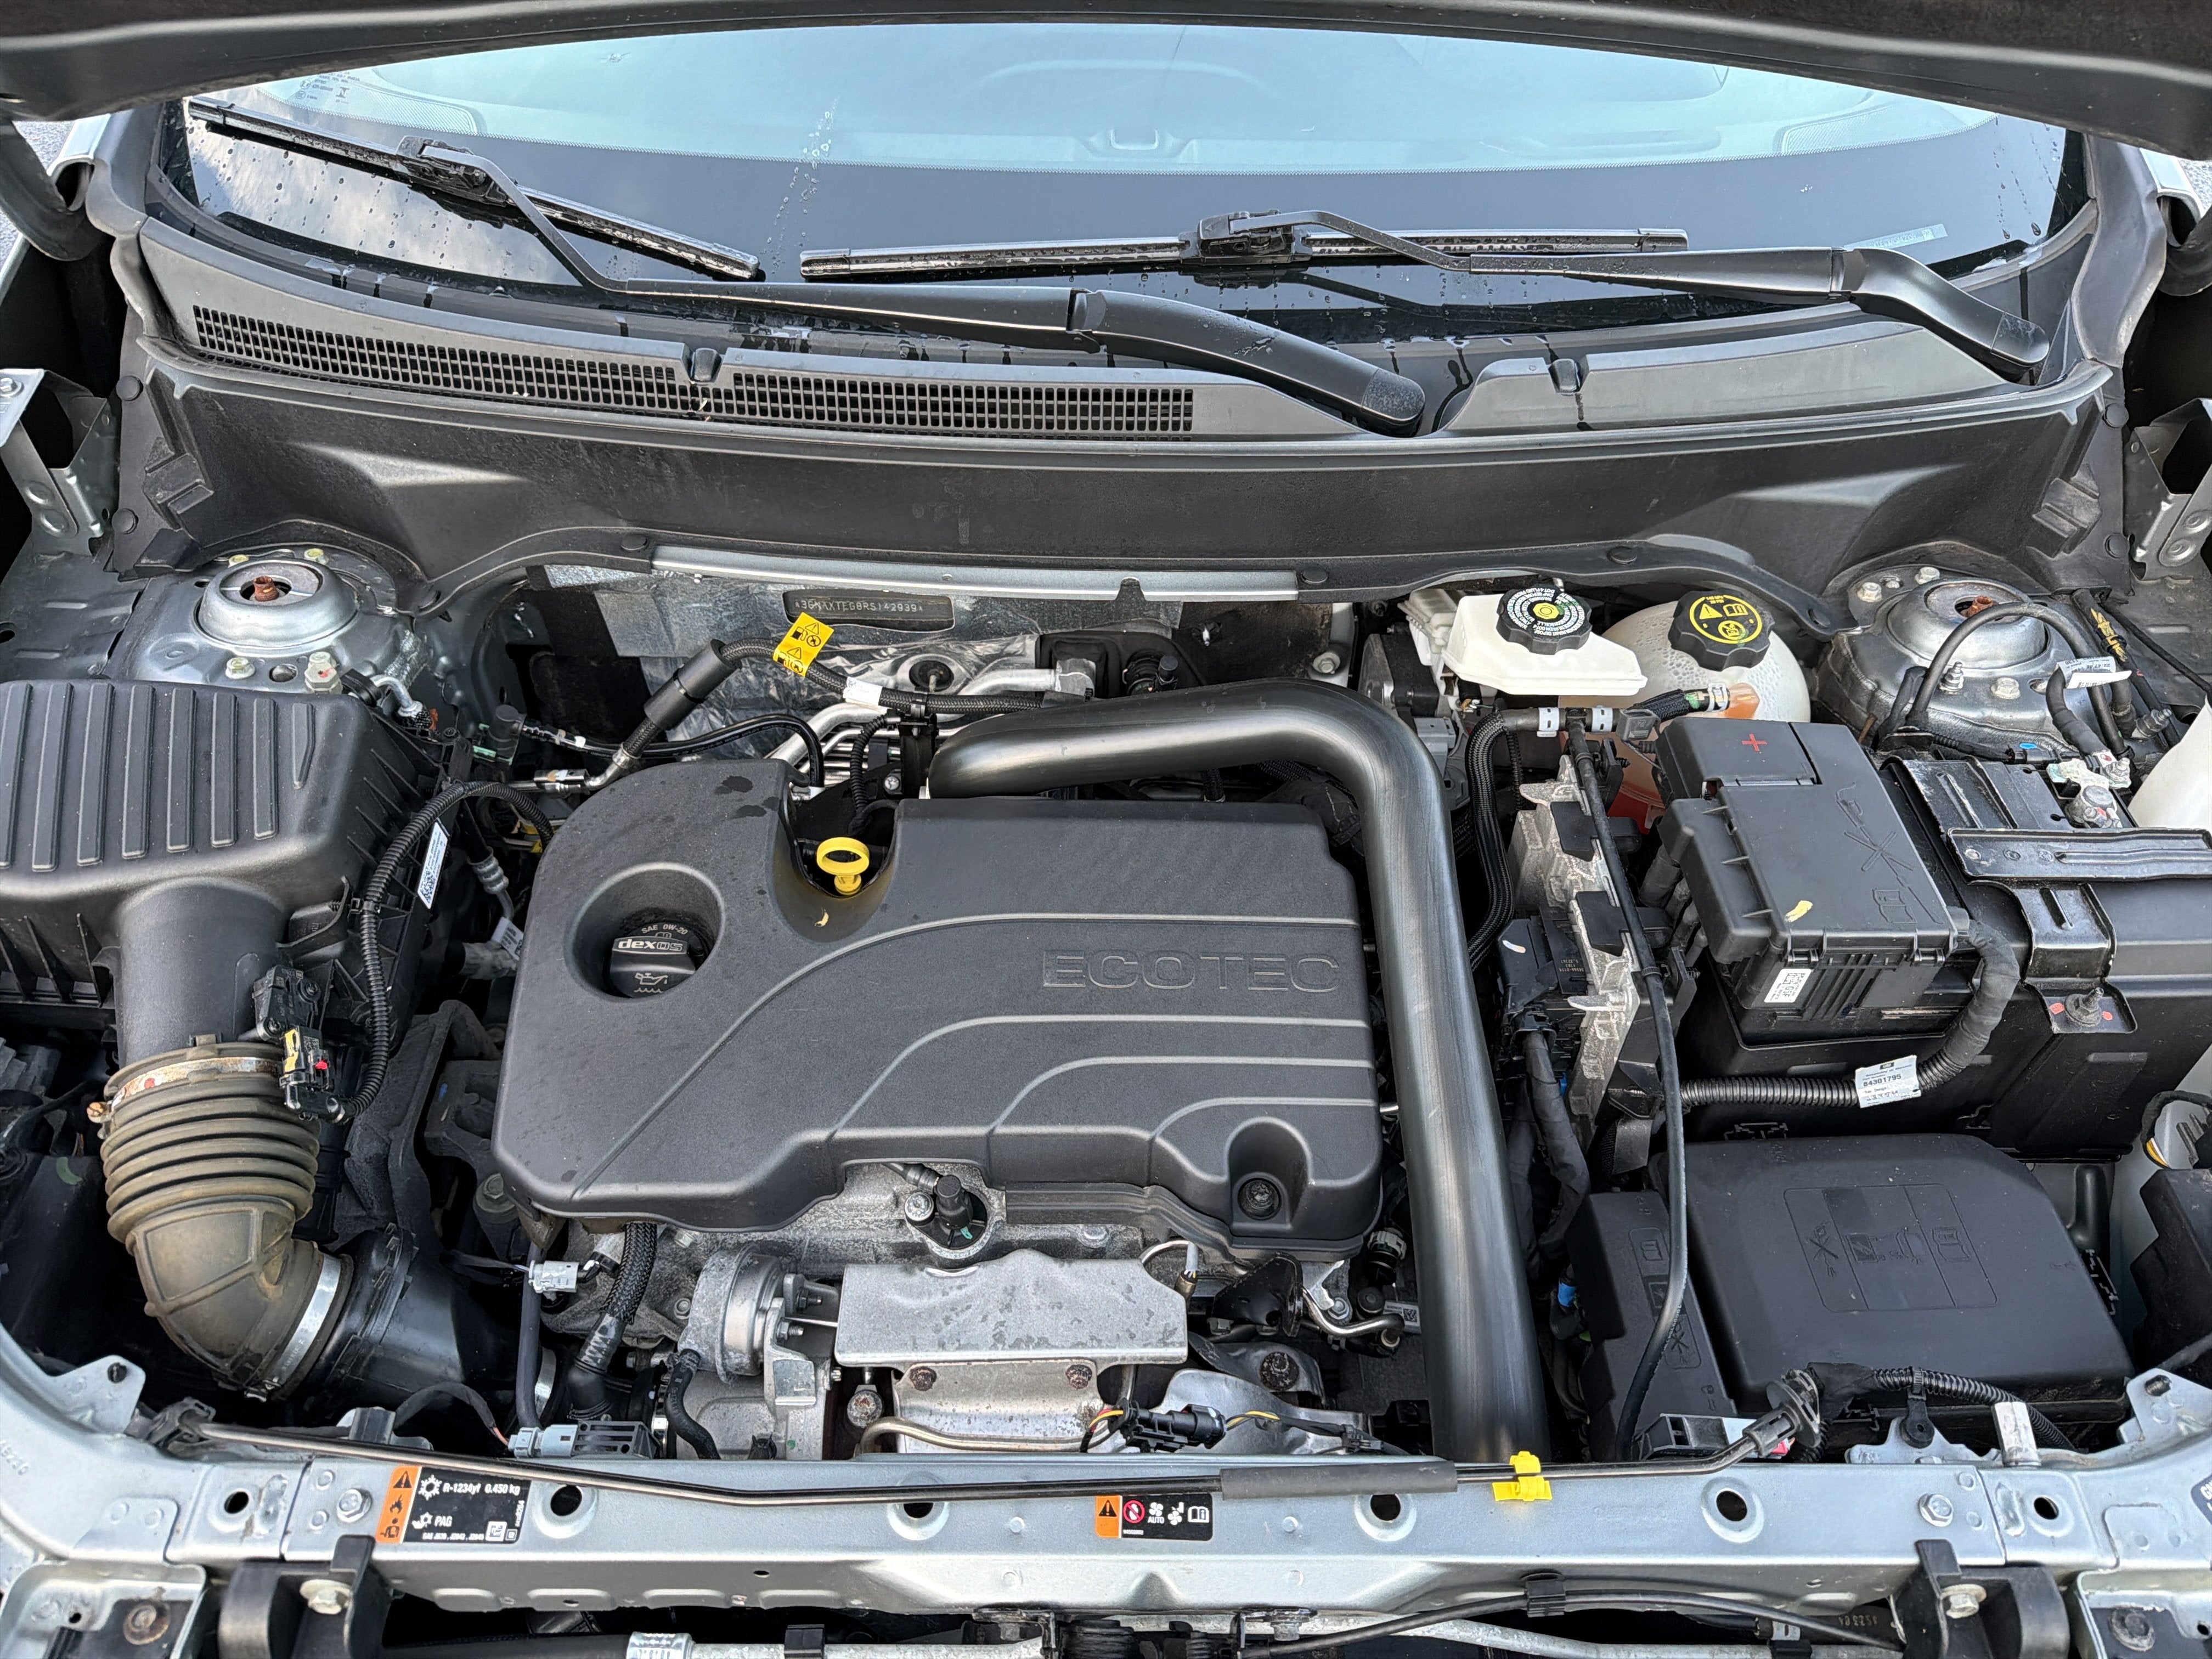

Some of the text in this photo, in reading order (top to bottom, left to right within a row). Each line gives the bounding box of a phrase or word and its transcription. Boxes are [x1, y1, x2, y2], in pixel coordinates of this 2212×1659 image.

[641, 923, 689, 935] SAE 0W-20
[618, 939, 683, 952] dexos
[1042, 950, 1340, 994] ECOTEC
[442, 1482, 521, 1497] R-1234yf 0.450 kg
[434, 1515, 453, 1527] PAG
